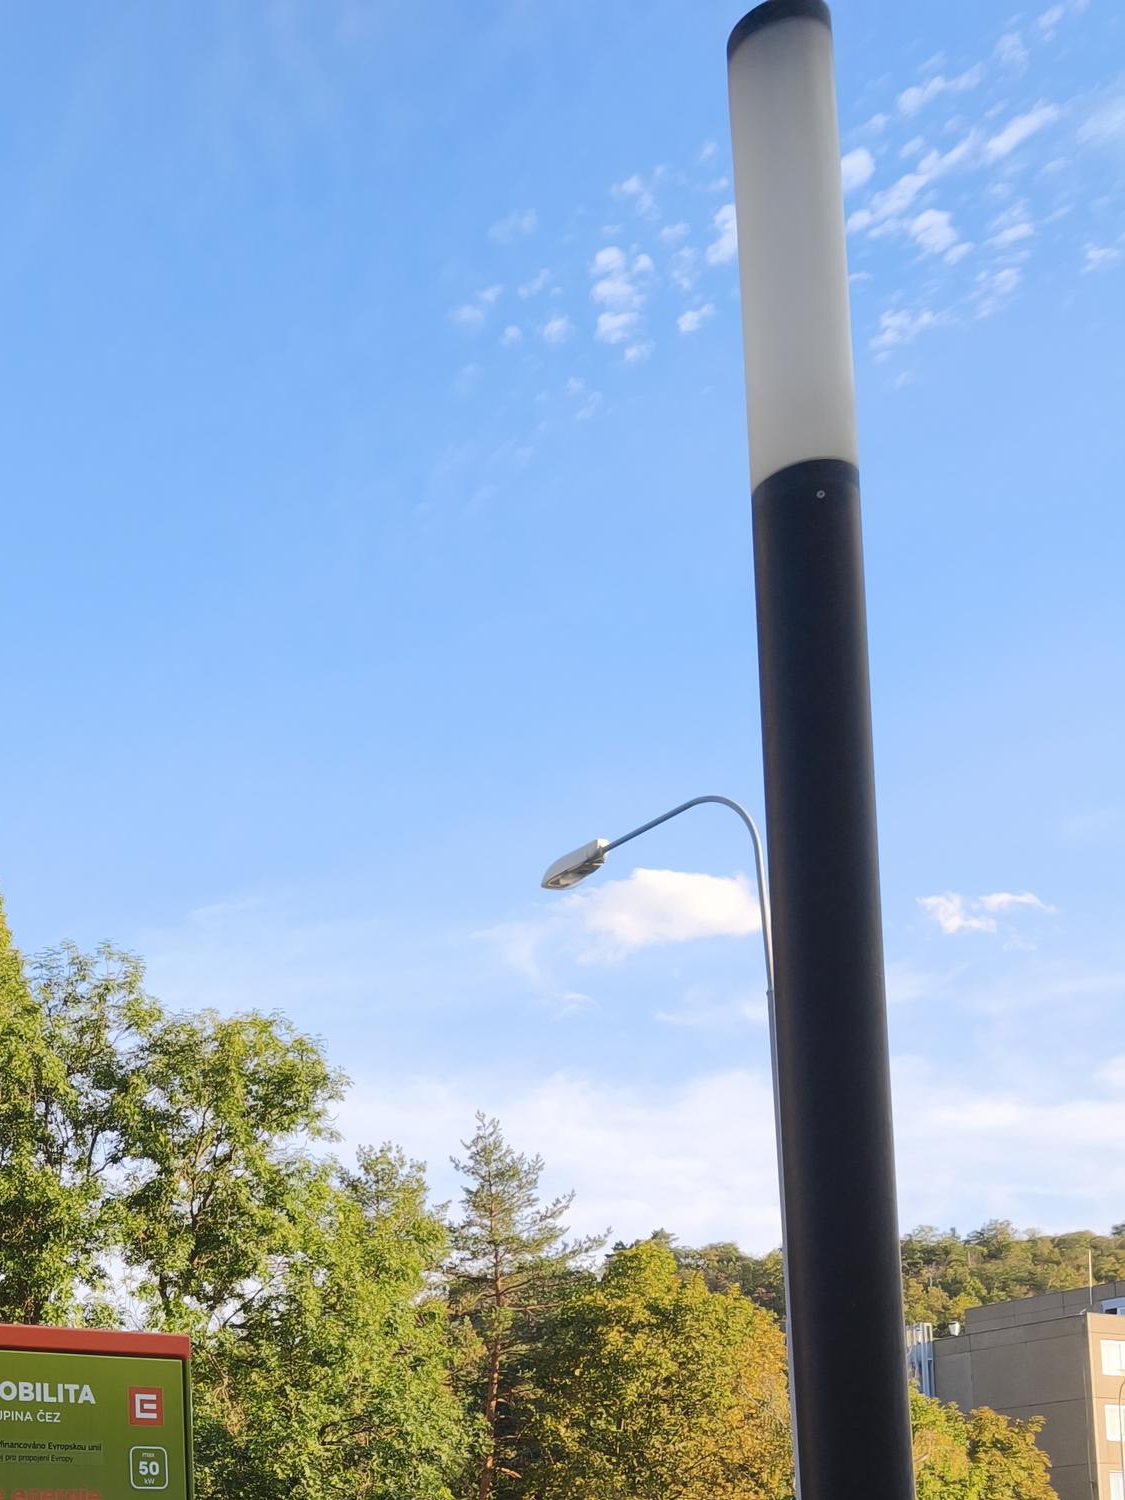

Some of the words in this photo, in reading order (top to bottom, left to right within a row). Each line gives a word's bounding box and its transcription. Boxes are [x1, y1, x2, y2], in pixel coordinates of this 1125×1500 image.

[36, 1409, 61, 1423] ČEZ
[48, 1441, 86, 1452] Evropskou
[139, 1461, 159, 1475] 50
